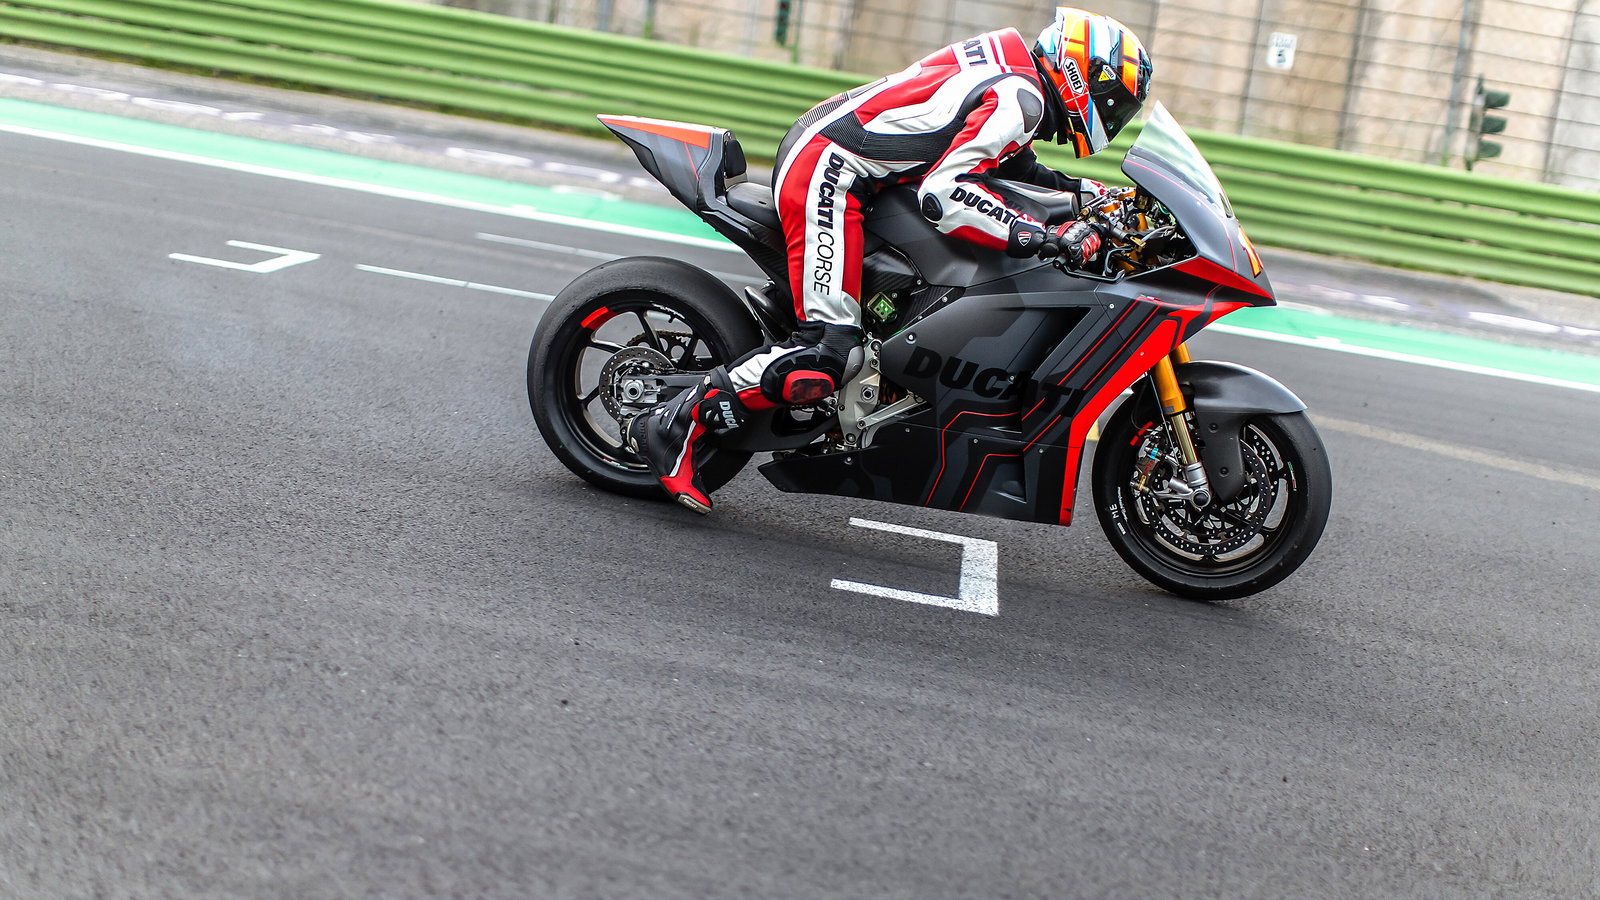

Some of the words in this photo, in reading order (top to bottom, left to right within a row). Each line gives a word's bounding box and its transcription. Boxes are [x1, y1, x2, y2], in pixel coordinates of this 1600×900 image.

[1065, 61, 1083, 91] SHOEI
[817, 152, 845, 230] DUCATI
[949, 186, 1016, 225] DUCAT
[813, 231, 835, 296] CORSE
[903, 346, 1087, 418] DUCATI
